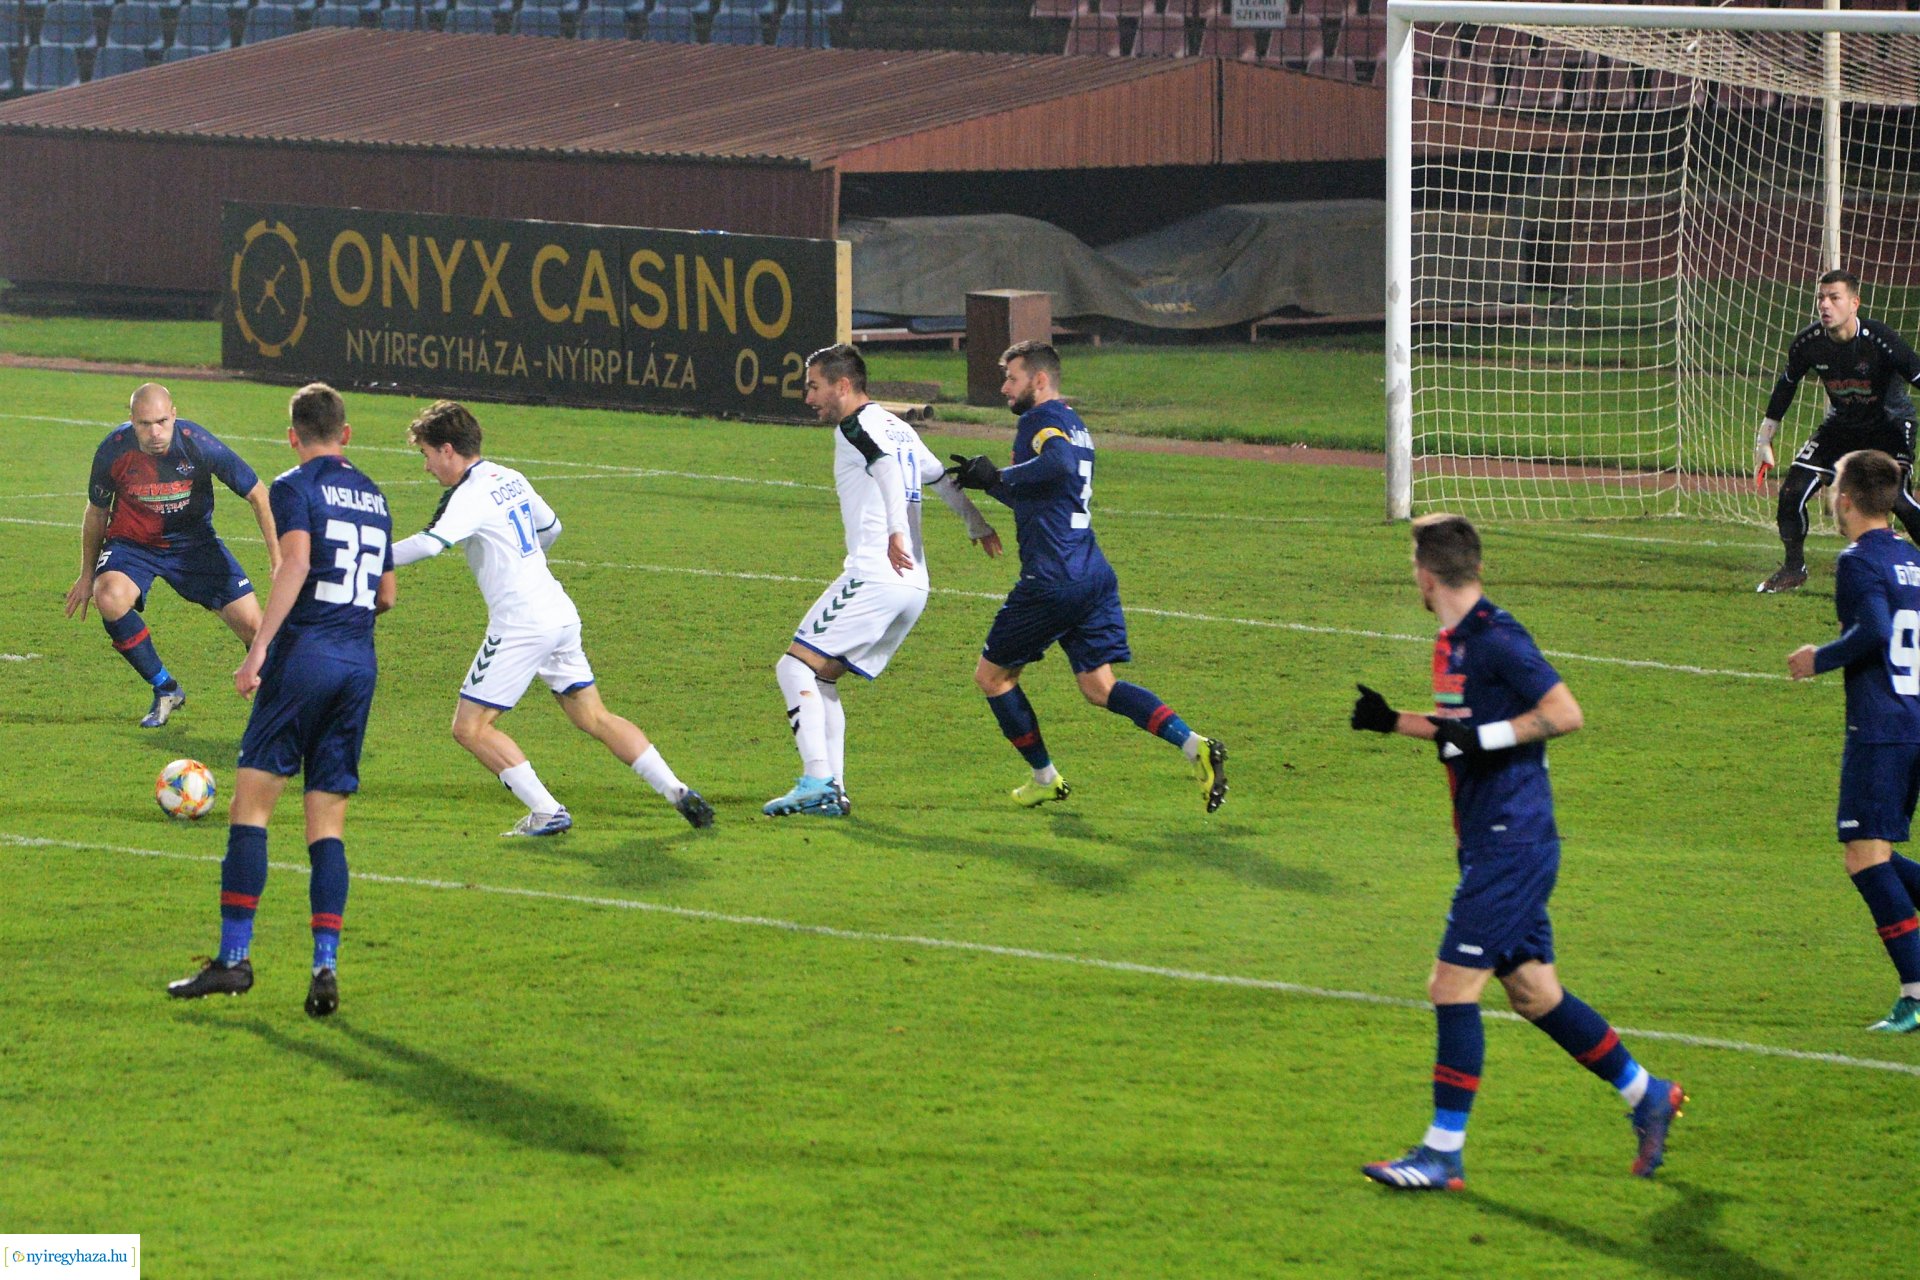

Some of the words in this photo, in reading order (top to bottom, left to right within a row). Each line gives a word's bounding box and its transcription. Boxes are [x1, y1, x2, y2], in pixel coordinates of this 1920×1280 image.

[328, 229, 514, 319] ONYX
[531, 244, 793, 340] CASINO
[506, 499, 538, 558] 17
[1070, 459, 1093, 529] 3
[314, 519, 388, 611] 32
